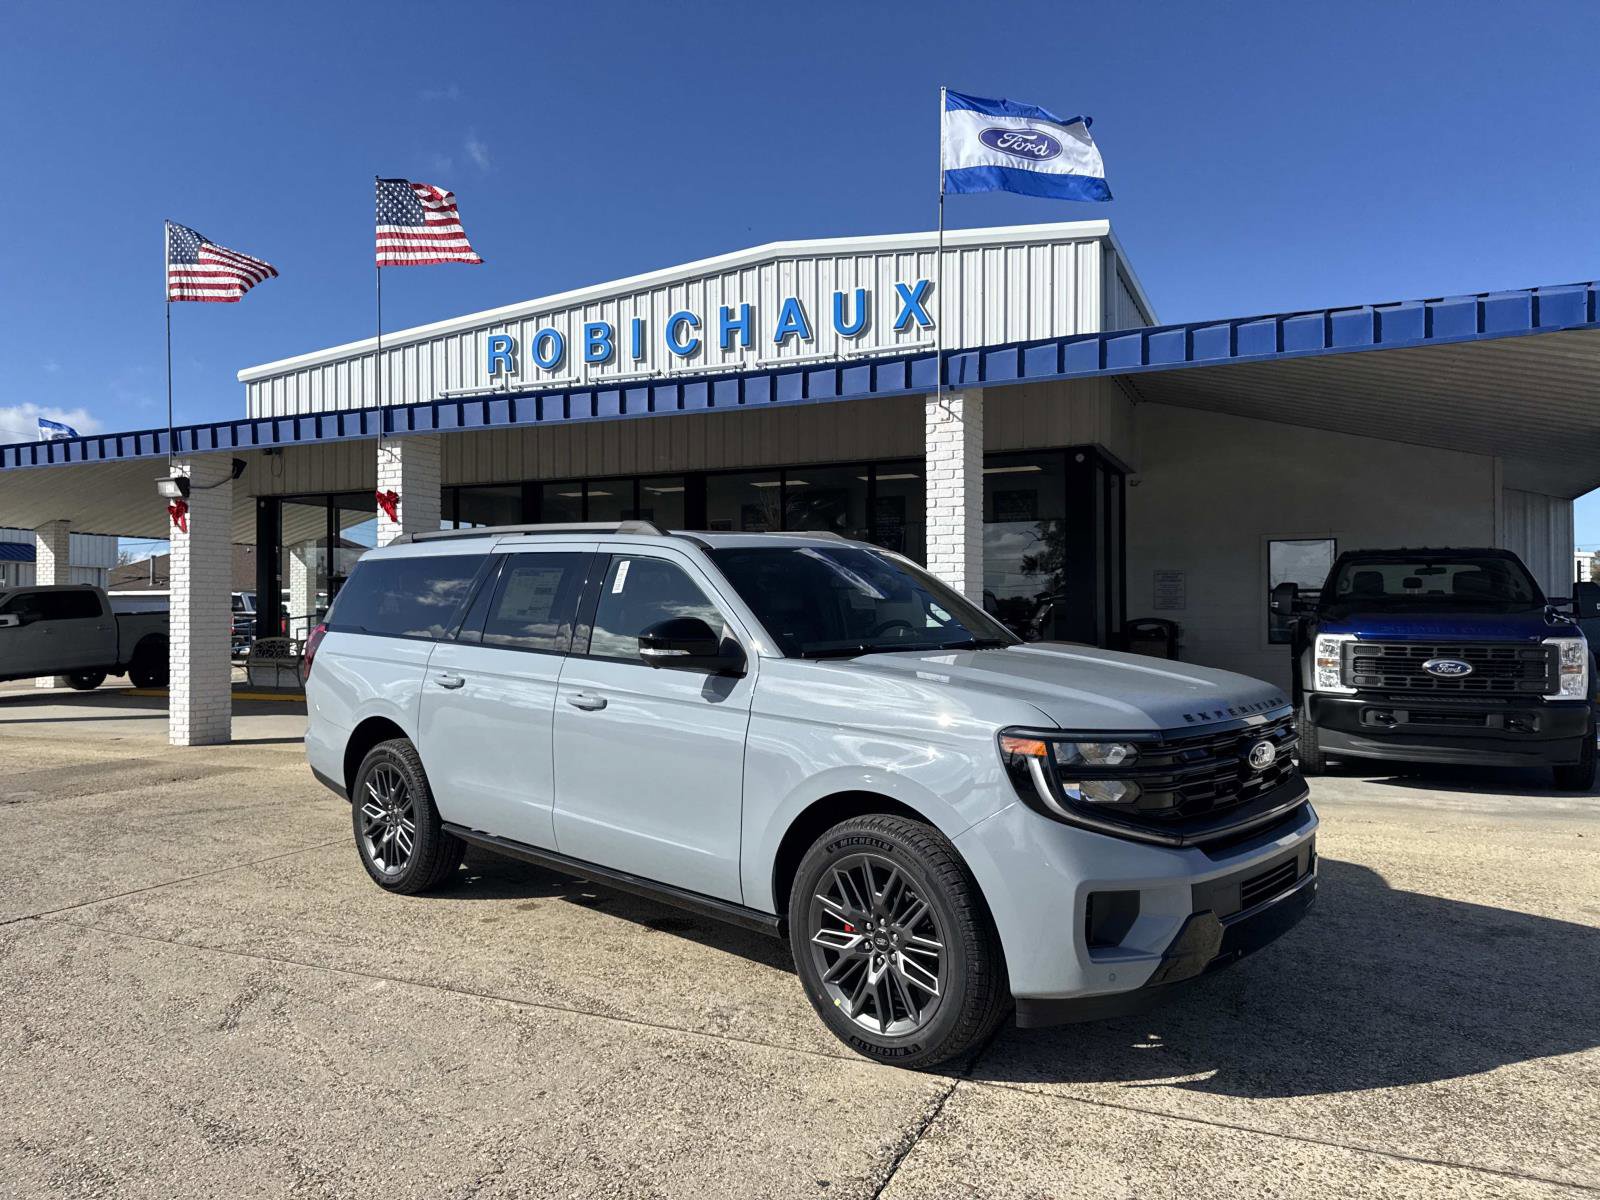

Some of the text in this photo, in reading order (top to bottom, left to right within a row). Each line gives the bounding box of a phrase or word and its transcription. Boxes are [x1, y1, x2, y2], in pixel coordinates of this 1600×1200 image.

[997, 132, 1050, 156] Ford
[487, 278, 936, 375] ROBICHAUX
[1436, 663, 1462, 673] Ford
[840, 837, 890, 850] MICHELIN
